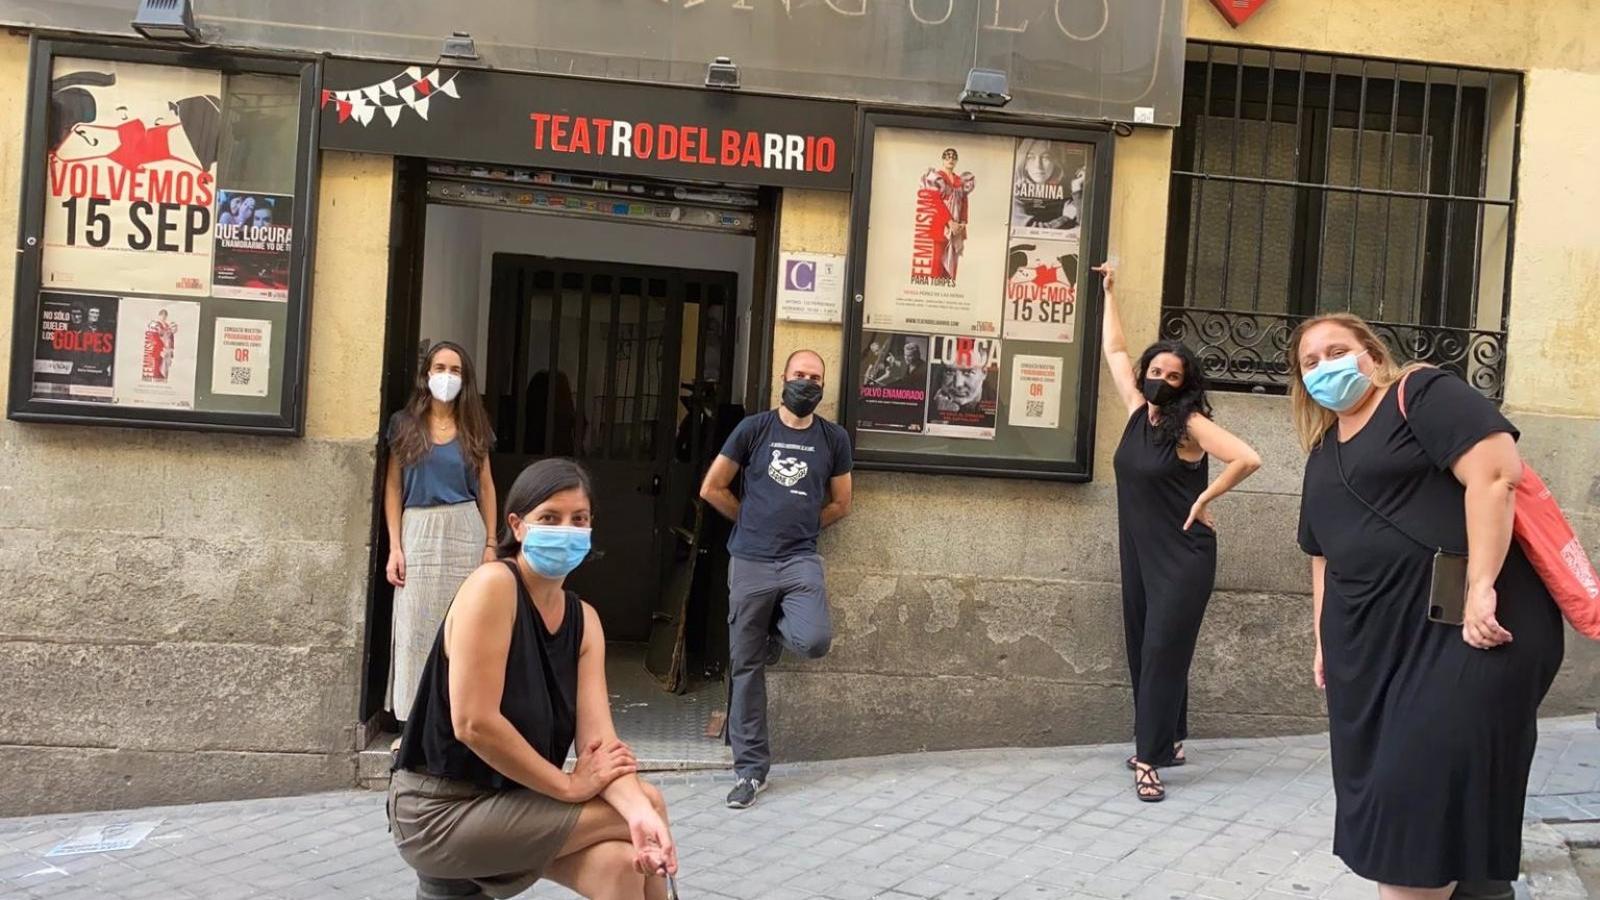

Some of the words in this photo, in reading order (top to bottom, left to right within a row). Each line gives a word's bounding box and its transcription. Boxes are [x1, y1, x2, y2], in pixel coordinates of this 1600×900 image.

[530, 112, 654, 160] TEATRO
[657, 123, 716, 165] DEL
[721, 129, 836, 173] BARRIO
[50, 161, 214, 207] VOLVEMOS
[1014, 182, 1064, 200] CARMINA
[62, 196, 112, 248] 15
[127, 201, 211, 253] SEP
[214, 223, 240, 240] QUE
[243, 225, 293, 244] LOCURA
[911, 188, 935, 278] FEMINISMO
[790, 261, 813, 290] C
[911, 277, 929, 286] PARA
[931, 278, 956, 288] TORPES
[1008, 282, 1075, 304] VOLVEMOS
[43, 310, 53, 320] NO
[1013, 298, 1033, 321] 15
[1039, 300, 1073, 324] SEP
[42, 321, 68, 331] DUELEN
[42, 331, 54, 340] LOS
[52, 329, 113, 353] GOLPES
[930, 335, 1000, 368] LORCA
[235, 348, 249, 362] QR
[883, 388, 924, 400] ENAMORADO
[1029, 383, 1043, 397] QR
